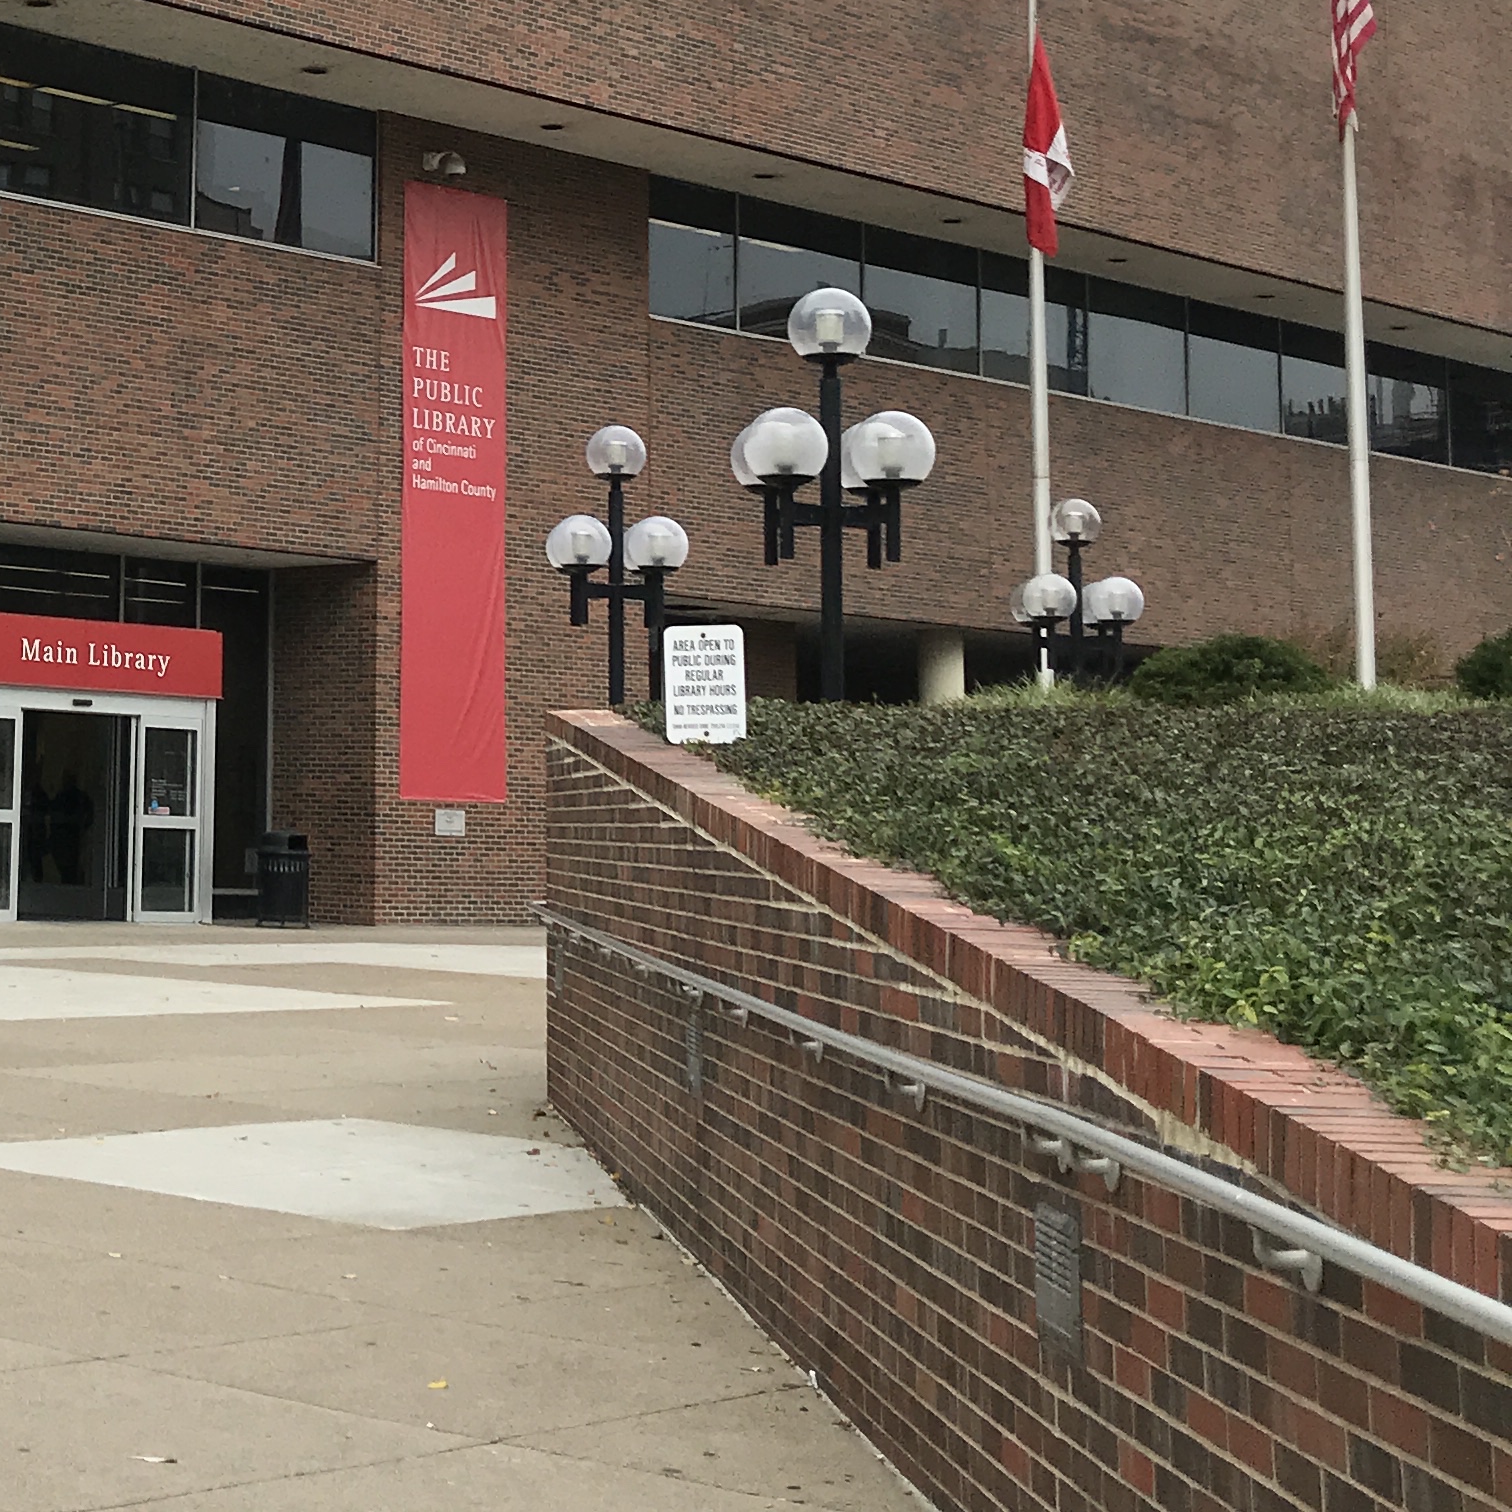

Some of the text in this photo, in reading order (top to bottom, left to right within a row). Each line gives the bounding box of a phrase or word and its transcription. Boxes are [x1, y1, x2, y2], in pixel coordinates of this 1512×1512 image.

[412, 346, 450, 372] THE
[412, 376, 483, 408] PUBLIC
[412, 407, 496, 439] LIBRARY
[412, 437, 477, 459] of Cincinnati
[412, 457, 432, 472] and
[412, 473, 497, 502] Hamilton County
[672, 638, 735, 652] AREA OPEN TO
[21, 638, 171, 678] Main Library
[672, 654, 736, 667] PUBLIC DURING
[685, 669, 724, 681] REGULAR
[673, 684, 737, 697] LIBRARY HOURS
[673, 704, 738, 715] NO TRESPASSING
